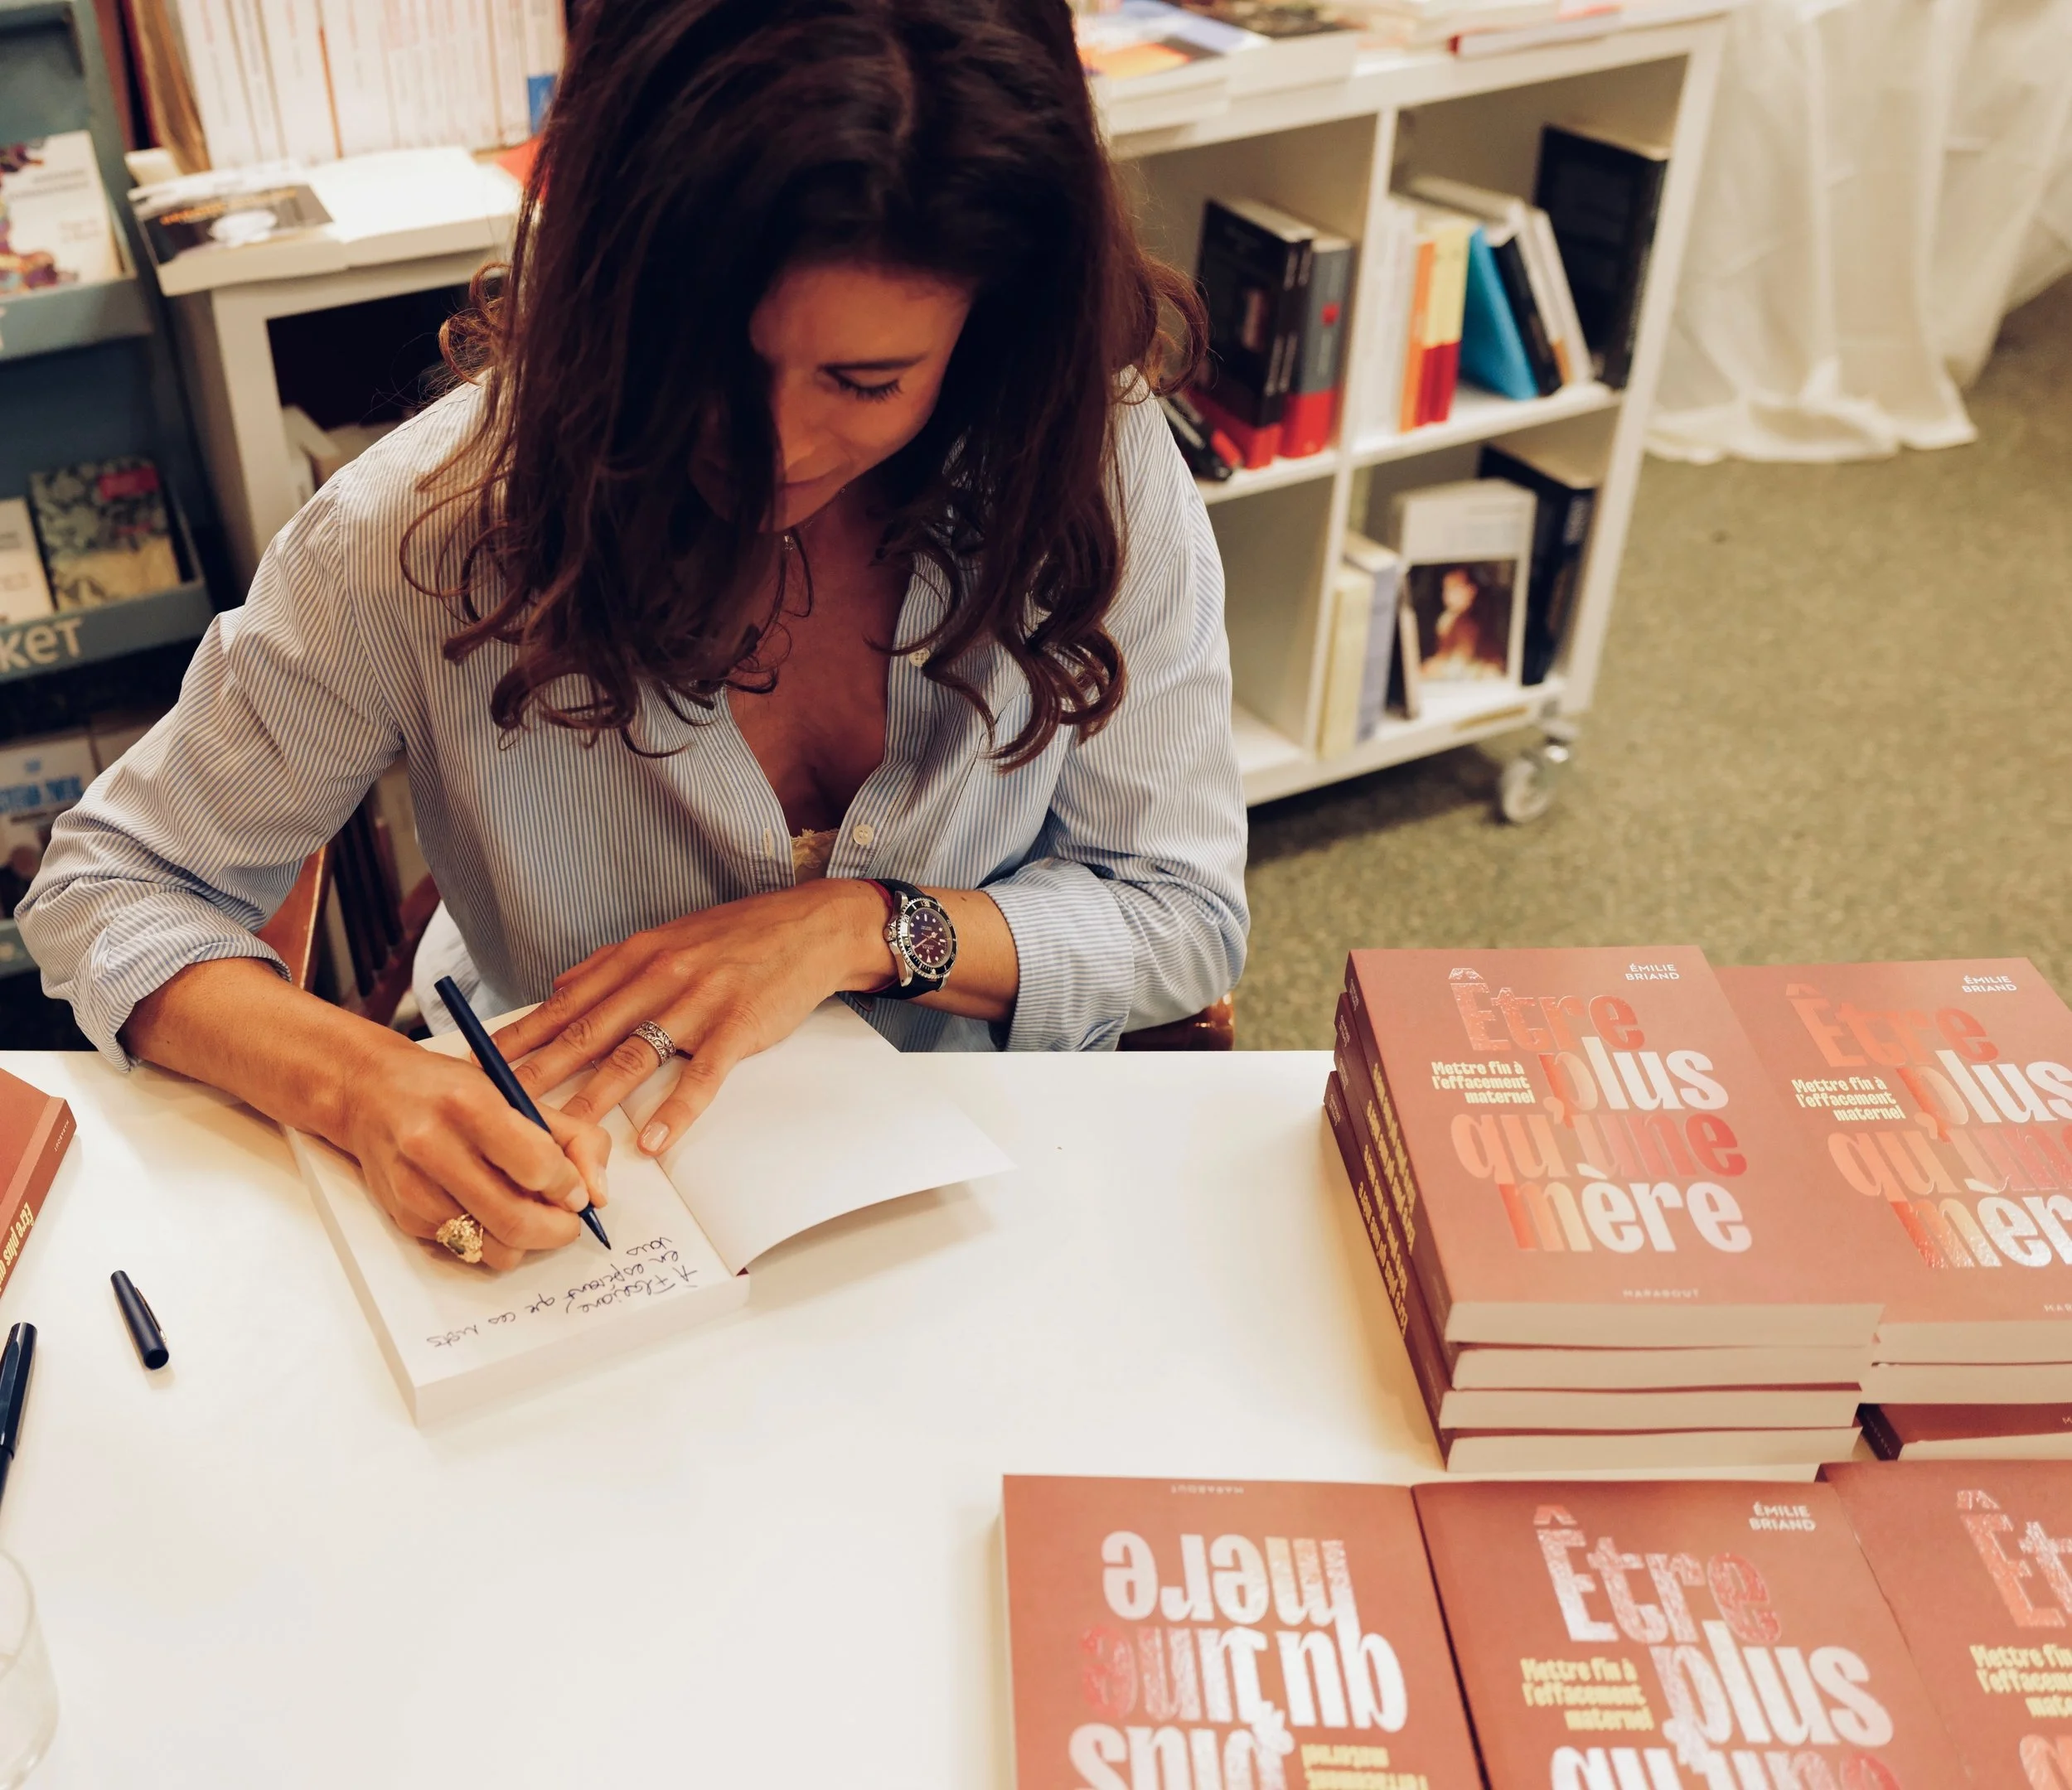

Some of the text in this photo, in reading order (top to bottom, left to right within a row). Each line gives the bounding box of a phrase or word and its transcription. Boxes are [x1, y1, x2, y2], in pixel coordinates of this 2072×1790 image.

[1624, 972, 1680, 980] BRIAND
[1629, 962, 1677, 973] ÉMILIE
[1962, 984, 2017, 994] BRIAND
[1963, 975, 2012, 984] ÉMILIE
[1448, 967, 1645, 1051] Être
[1785, 983, 2000, 1067] Être
[1431, 1060, 1525, 1076] Mettre fin à
[1431, 1075, 1532, 1091] l'effacement
[1538, 1036, 1729, 1129] plus
[1791, 1076, 1887, 1094] Mettre fin à
[1464, 1089, 1537, 1105] maternel
[1795, 1091, 1897, 1108] l'effacement
[1895, 1049, 2072, 1143] plus
[1832, 1104, 1906, 1121] maternel
[54, 1120, 70, 1152] MARABOUT
[1450, 1096, 1747, 1185] qu'une
[1828, 1112, 2072, 1202] qu'un
[1498, 1163, 1753, 1253] mère
[16, 1202, 34, 1238] Être
[3, 1226, 20, 1266] plus
[648, 1251, 678, 1263] en
[564, 1263, 644, 1299] espérant
[525, 1293, 555, 1313] que
[1622, 1288, 1701, 1299] MARABOUT
[487, 1312, 516, 1324] ces
[1753, 1501, 1810, 1518] ÉMILIE
[1749, 1517, 1817, 1532] BRIAND
[1533, 1503, 1783, 1644] Être
[1969, 1644, 2044, 1669] Mettre
[1520, 1657, 1591, 1682] Mettre
[1649, 1620, 1894, 1769] plus
